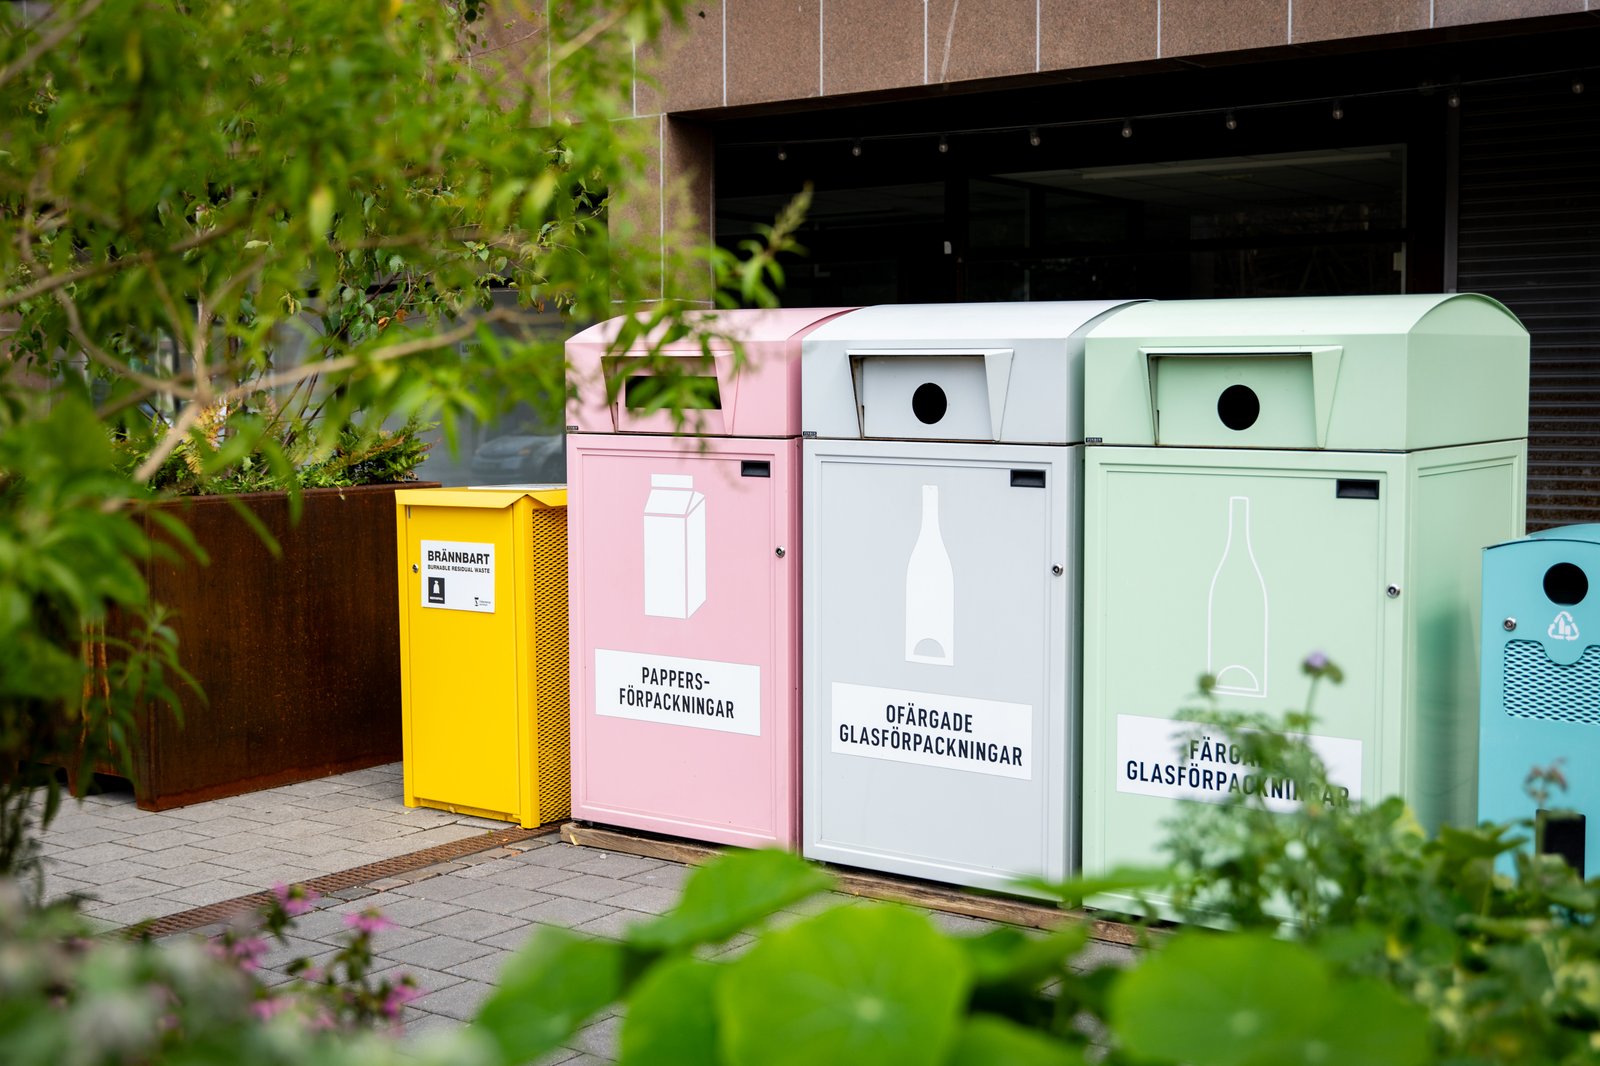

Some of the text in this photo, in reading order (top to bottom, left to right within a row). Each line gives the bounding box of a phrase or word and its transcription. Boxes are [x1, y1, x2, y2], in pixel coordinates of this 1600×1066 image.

[427, 548, 490, 565] BRÄNNBART
[428, 564, 451, 572] BURNABLE
[641, 666, 710, 691] PAPPERS-
[619, 684, 735, 719] FÖRPACKNINGAR
[885, 702, 973, 734] OFÄRGADE
[839, 724, 1023, 767] GLASFÖRPACKNINGAR
